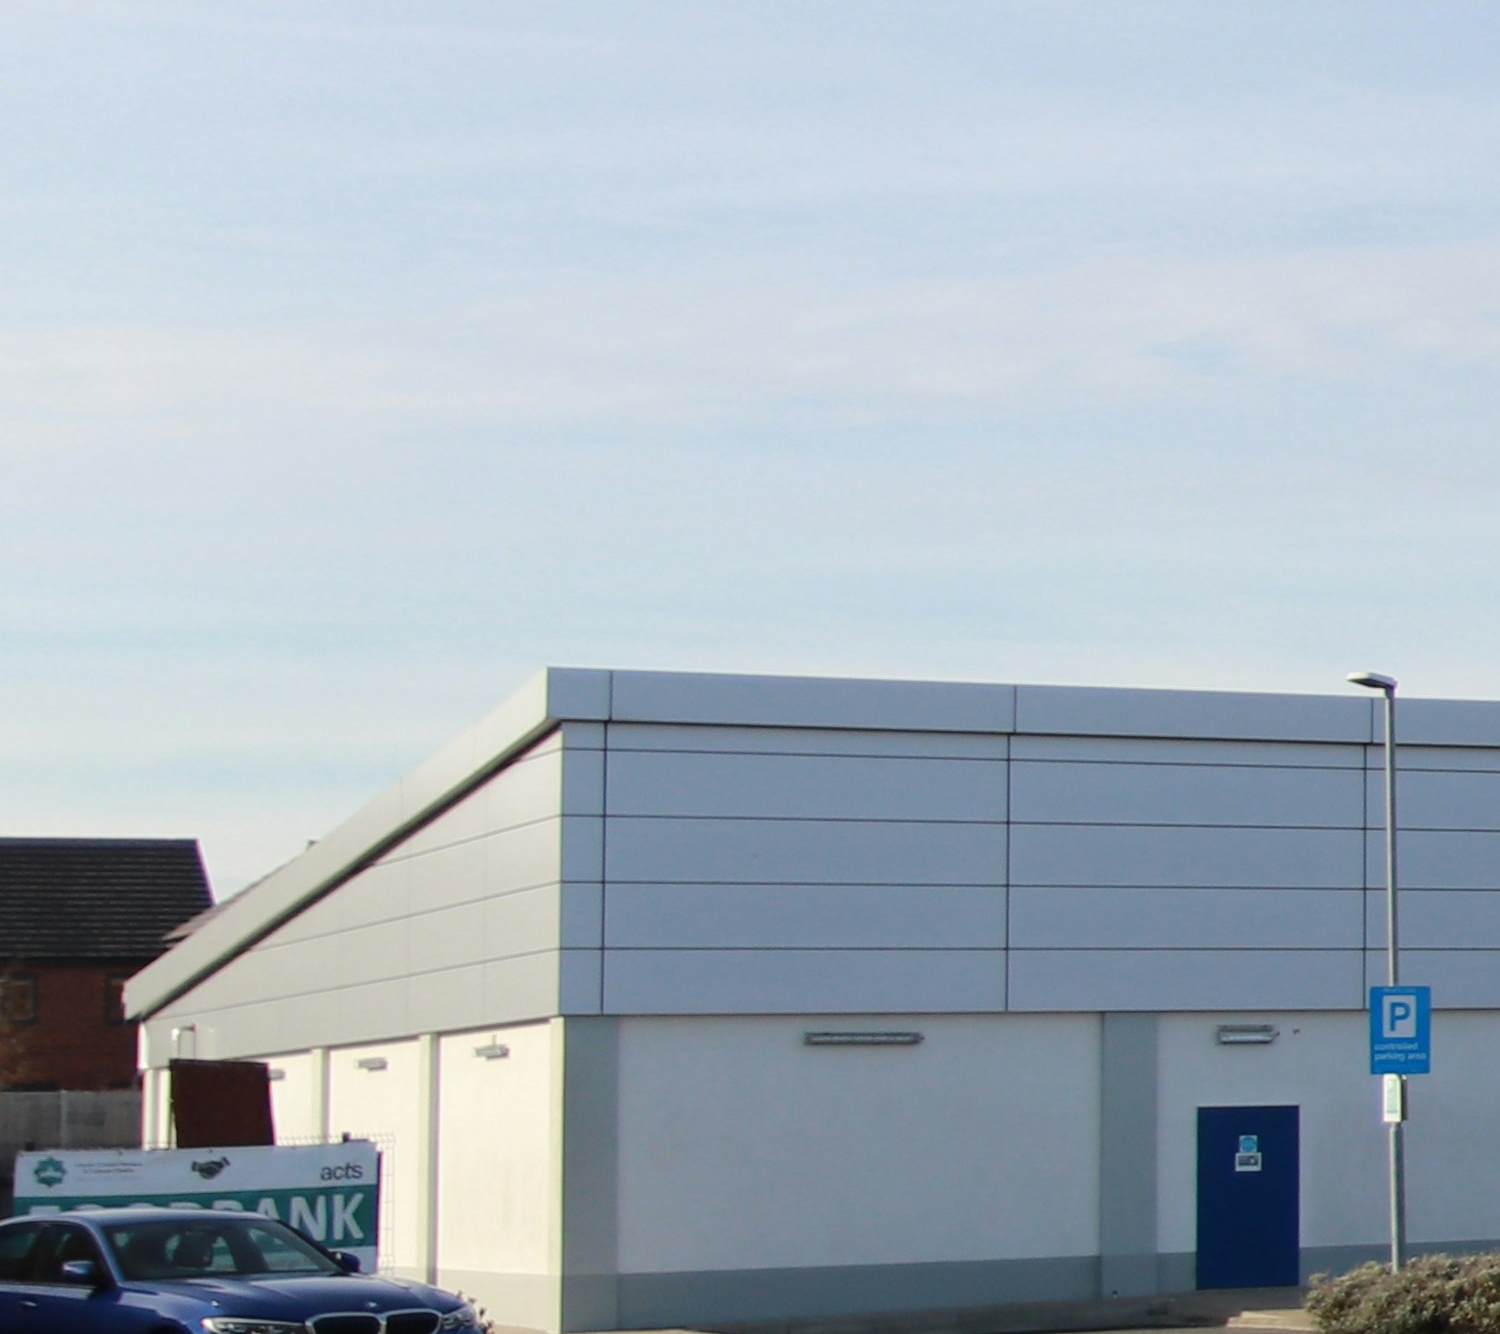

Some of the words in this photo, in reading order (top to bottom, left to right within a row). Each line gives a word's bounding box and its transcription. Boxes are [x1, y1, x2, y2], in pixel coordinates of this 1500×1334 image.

[1390, 1002, 1411, 1032] P
[1374, 1052, 1406, 1062] parking
[321, 1162, 364, 1180] acts
